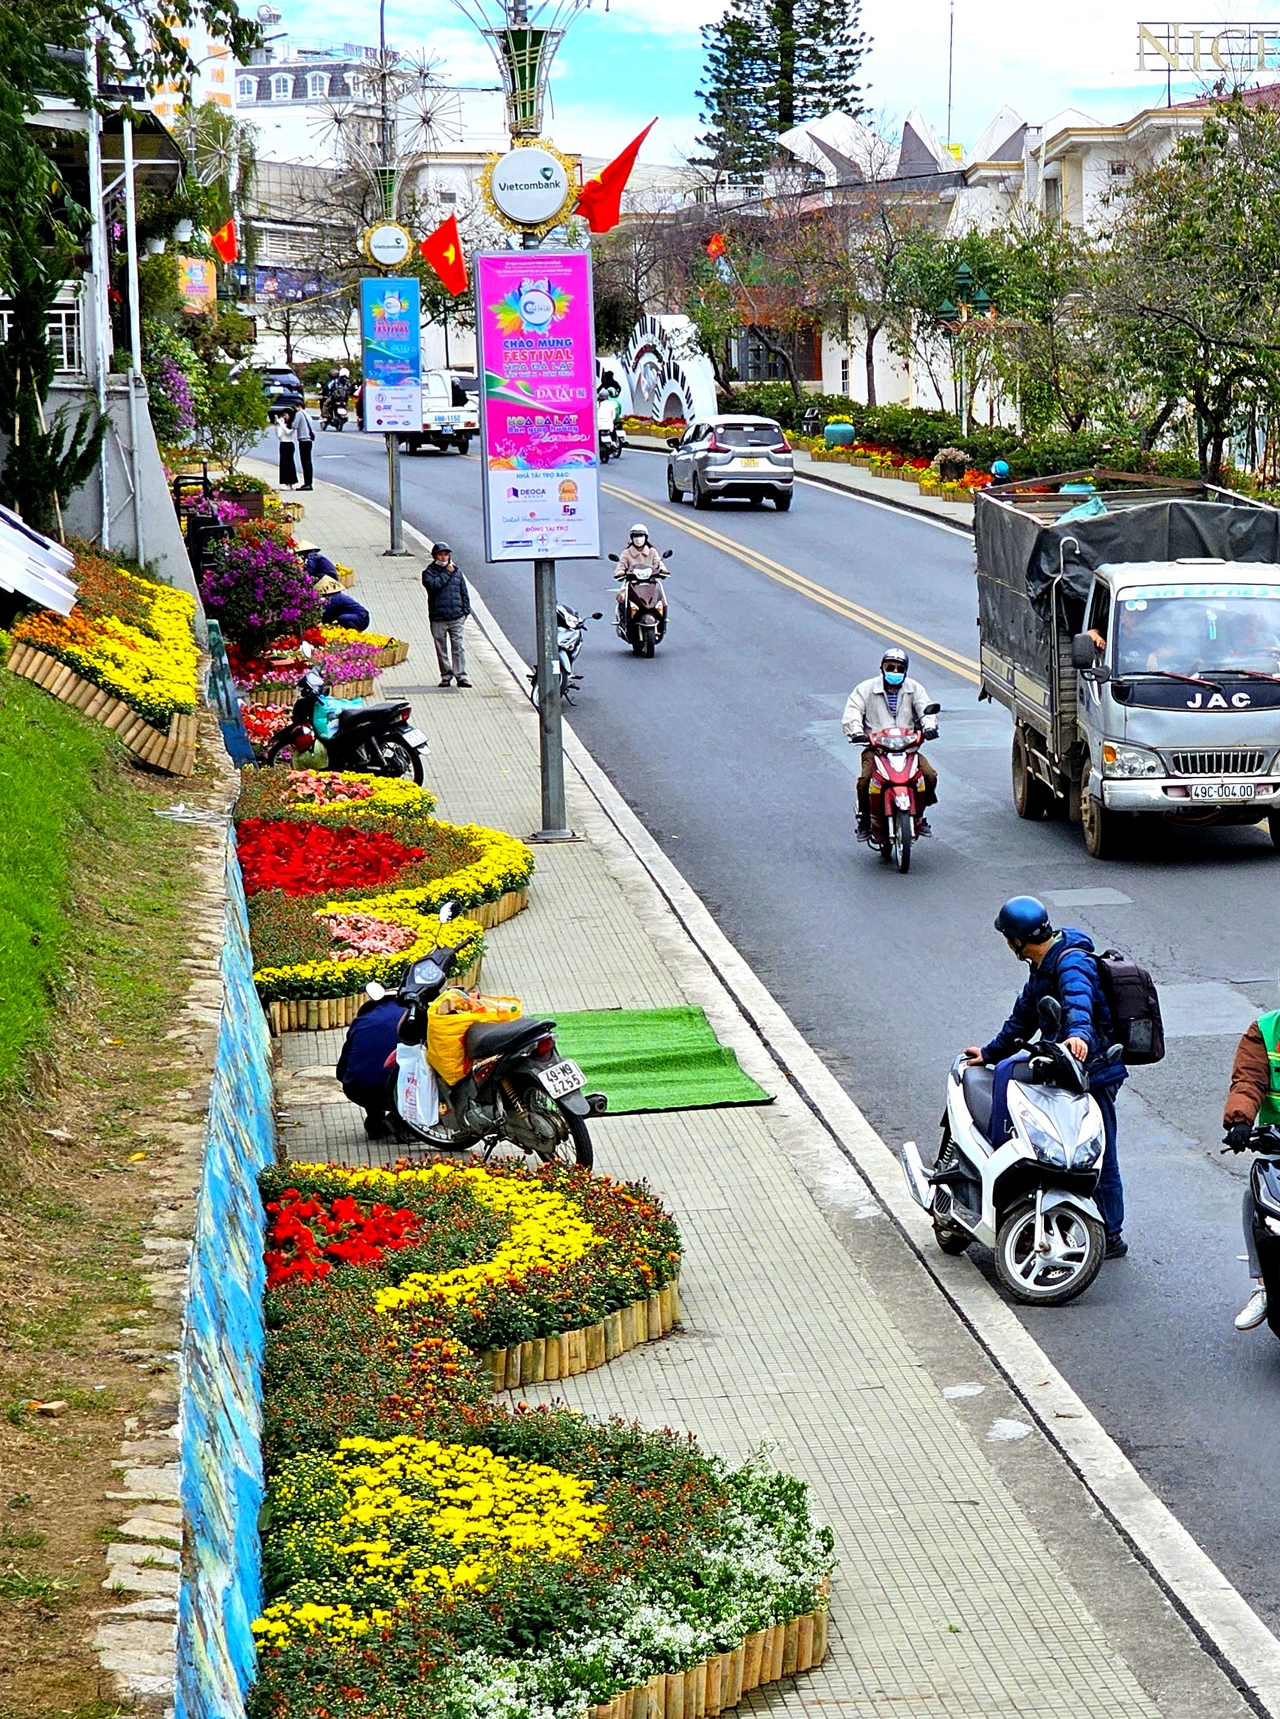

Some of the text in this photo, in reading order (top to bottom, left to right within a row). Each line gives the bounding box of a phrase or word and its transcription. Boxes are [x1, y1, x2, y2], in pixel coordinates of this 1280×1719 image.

[1135, 23, 1278, 72] NICE
[499, 180, 561, 191] Vietcombank
[503, 350, 574, 361] FESTIVAL
[507, 416, 532, 426] HOA
[1186, 692, 1251, 708] JAC
[1193, 785, 1253, 798] 49C-004.00
[546, 1063, 574, 1083] 49-M9
[552, 1075, 581, 1096] 4255
